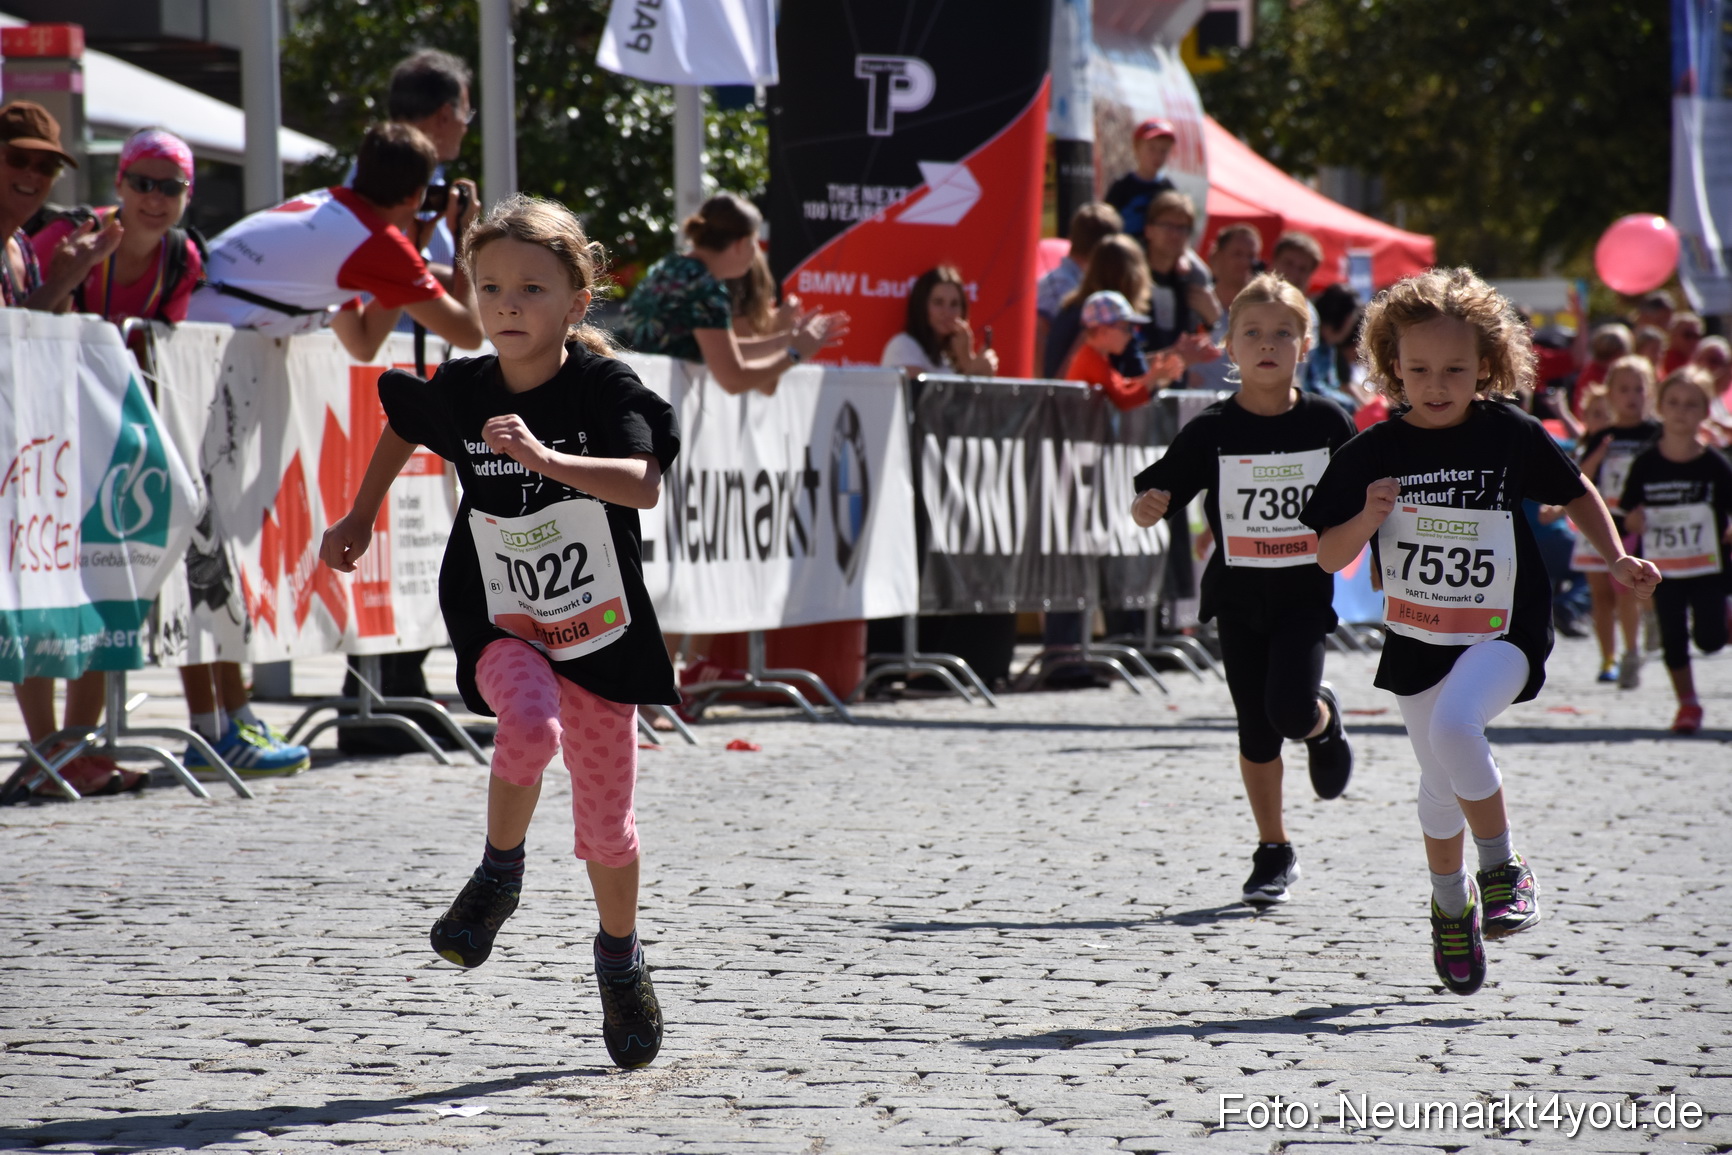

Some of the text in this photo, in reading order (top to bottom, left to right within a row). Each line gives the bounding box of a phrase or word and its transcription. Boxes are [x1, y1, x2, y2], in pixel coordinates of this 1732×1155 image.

[827, 184, 909, 203] THE NEXT
[798, 270, 856, 294] BMW
[1253, 464, 1304, 479] BOCK
[665, 434, 820, 565] Neumarkt
[922, 433, 1027, 556] MINI
[500, 519, 561, 548] BOCK
[1272, 525, 1306, 533] Neumarkt
[1417, 517, 1479, 536] BOCK
[1653, 525, 1703, 547] 7517
[1254, 540, 1309, 555] Theresa
[495, 542, 595, 602] 7022
[1397, 541, 1496, 588] 7535
[1405, 588, 1472, 603] PARTL Neumarkt
[536, 599, 581, 617] Neumarkt
[1400, 603, 1440, 625] HELENA
